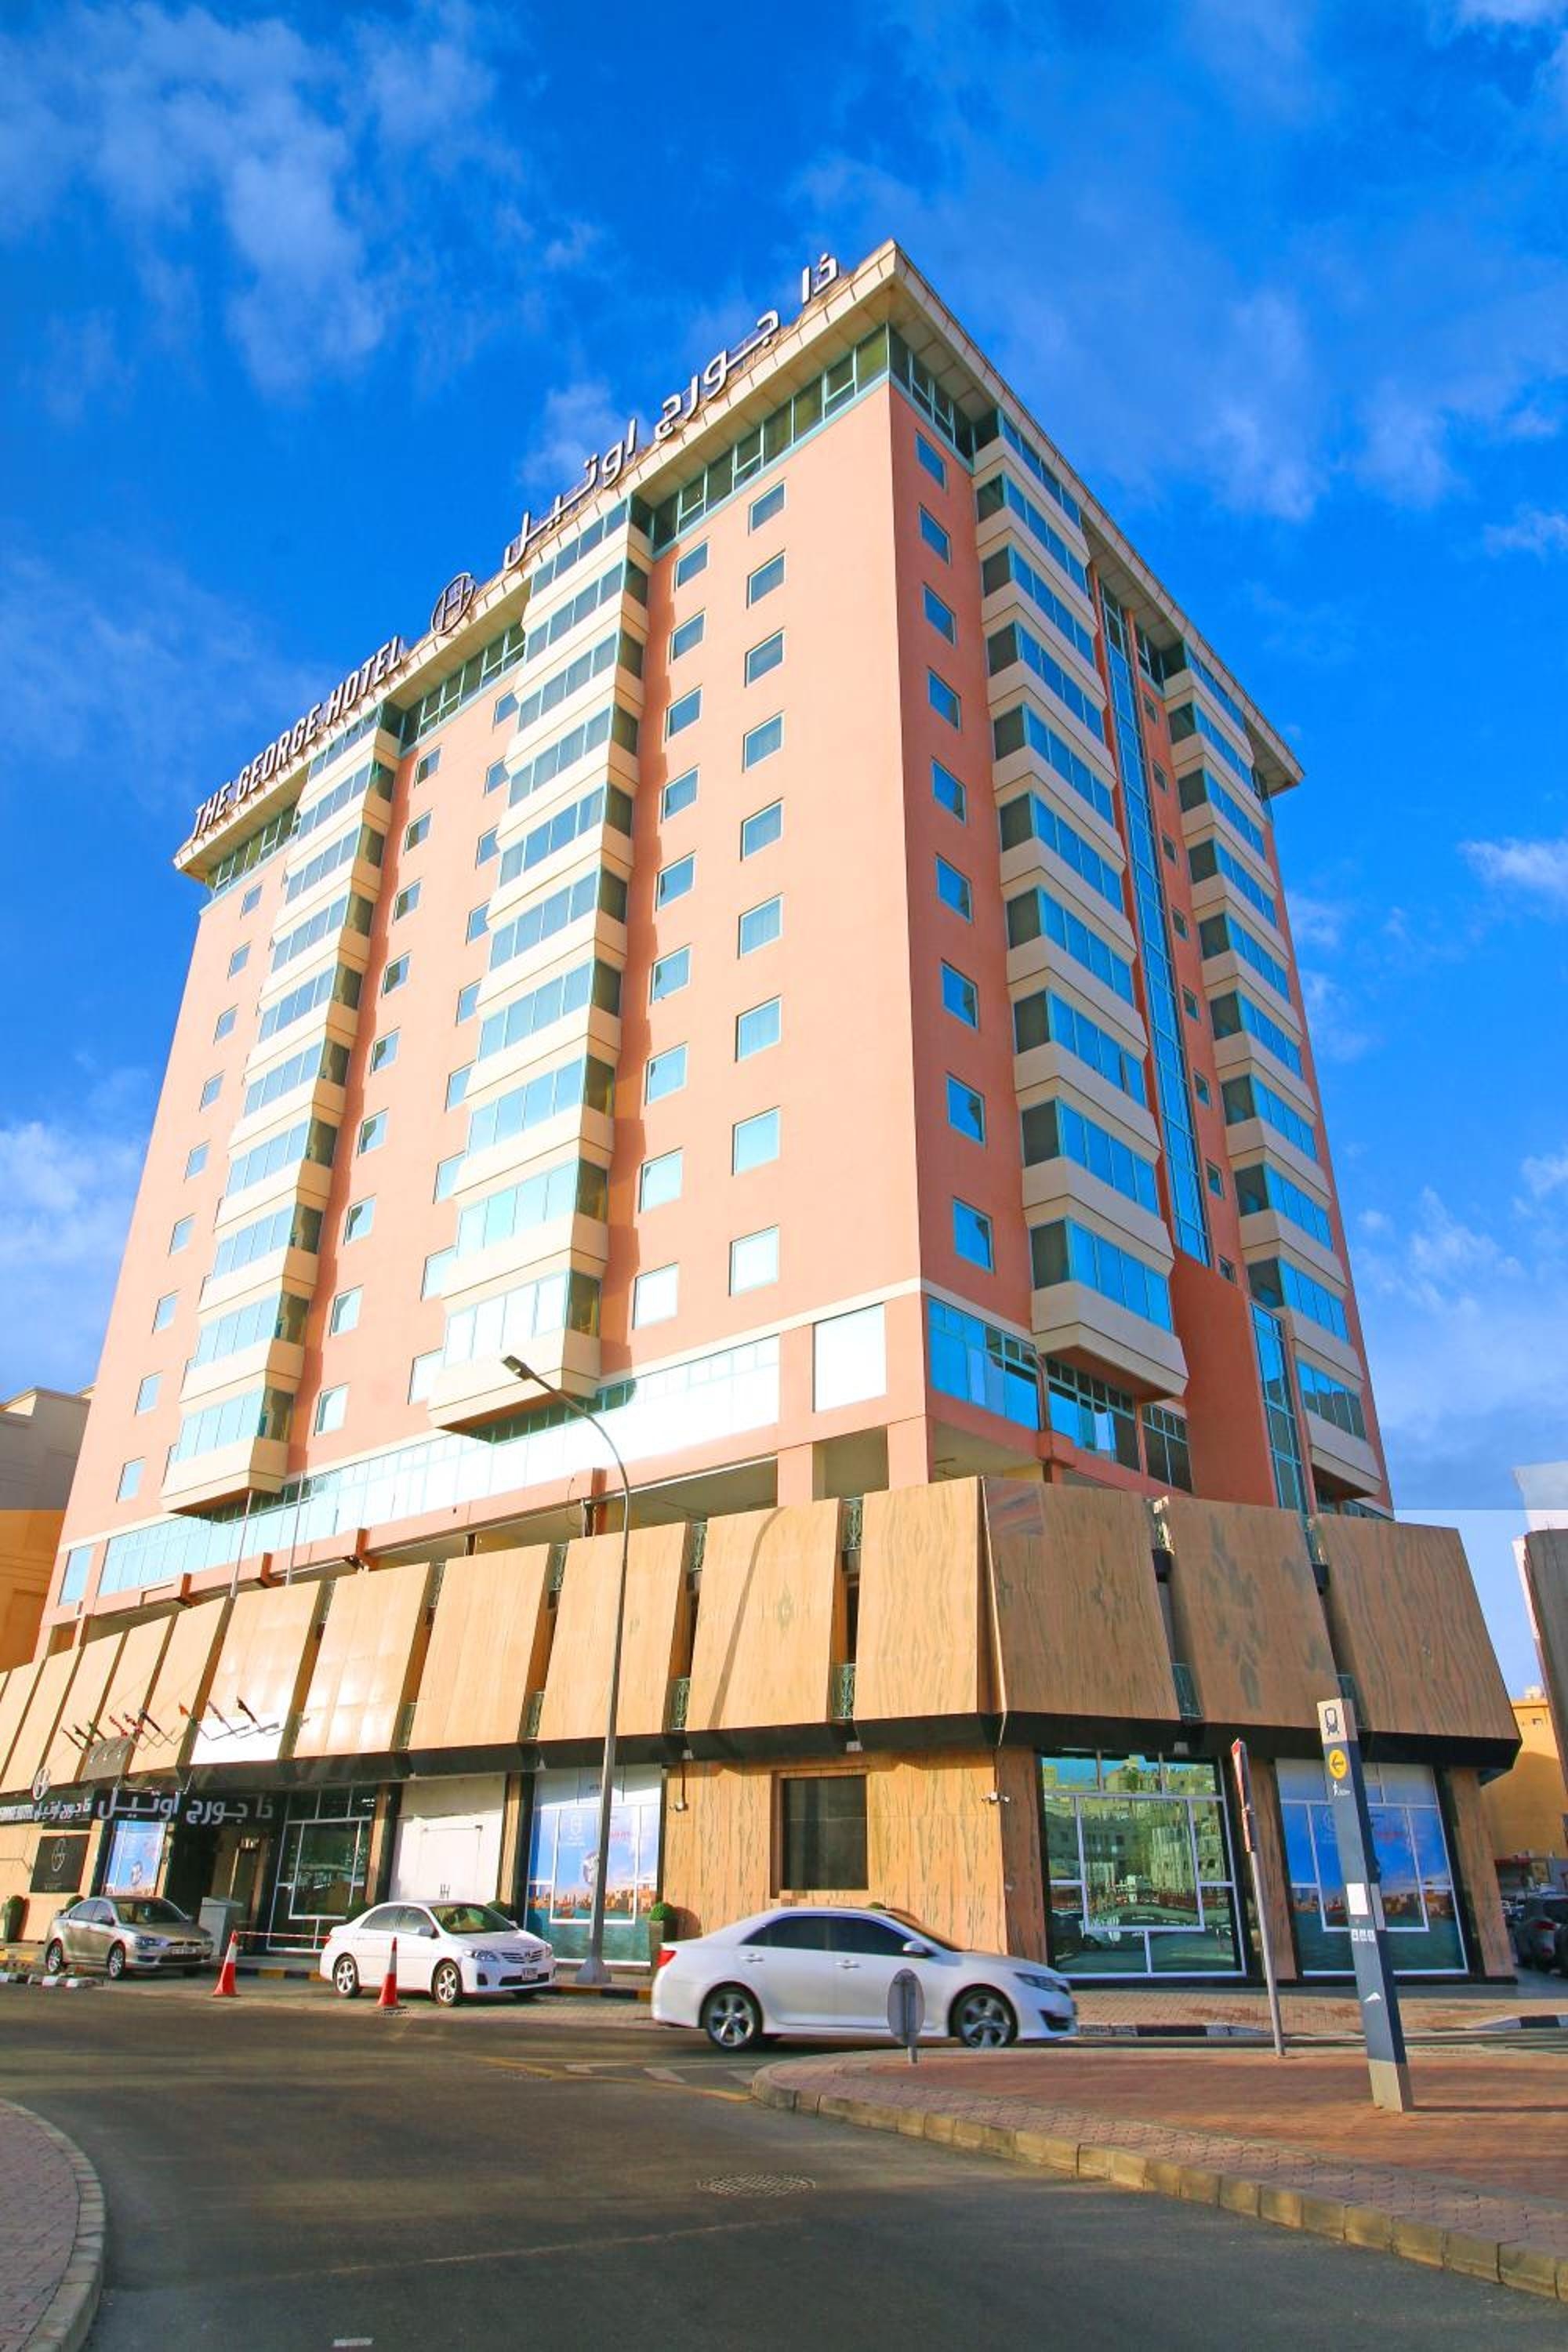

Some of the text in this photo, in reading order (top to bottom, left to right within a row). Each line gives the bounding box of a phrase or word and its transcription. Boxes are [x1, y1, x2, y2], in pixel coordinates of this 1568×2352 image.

[802, 252, 840, 305] ذا
[654, 310, 780, 441] جورج
[193, 635, 402, 840] THE GEORGE HOTEL
[186, 1798, 249, 1825] جورج
